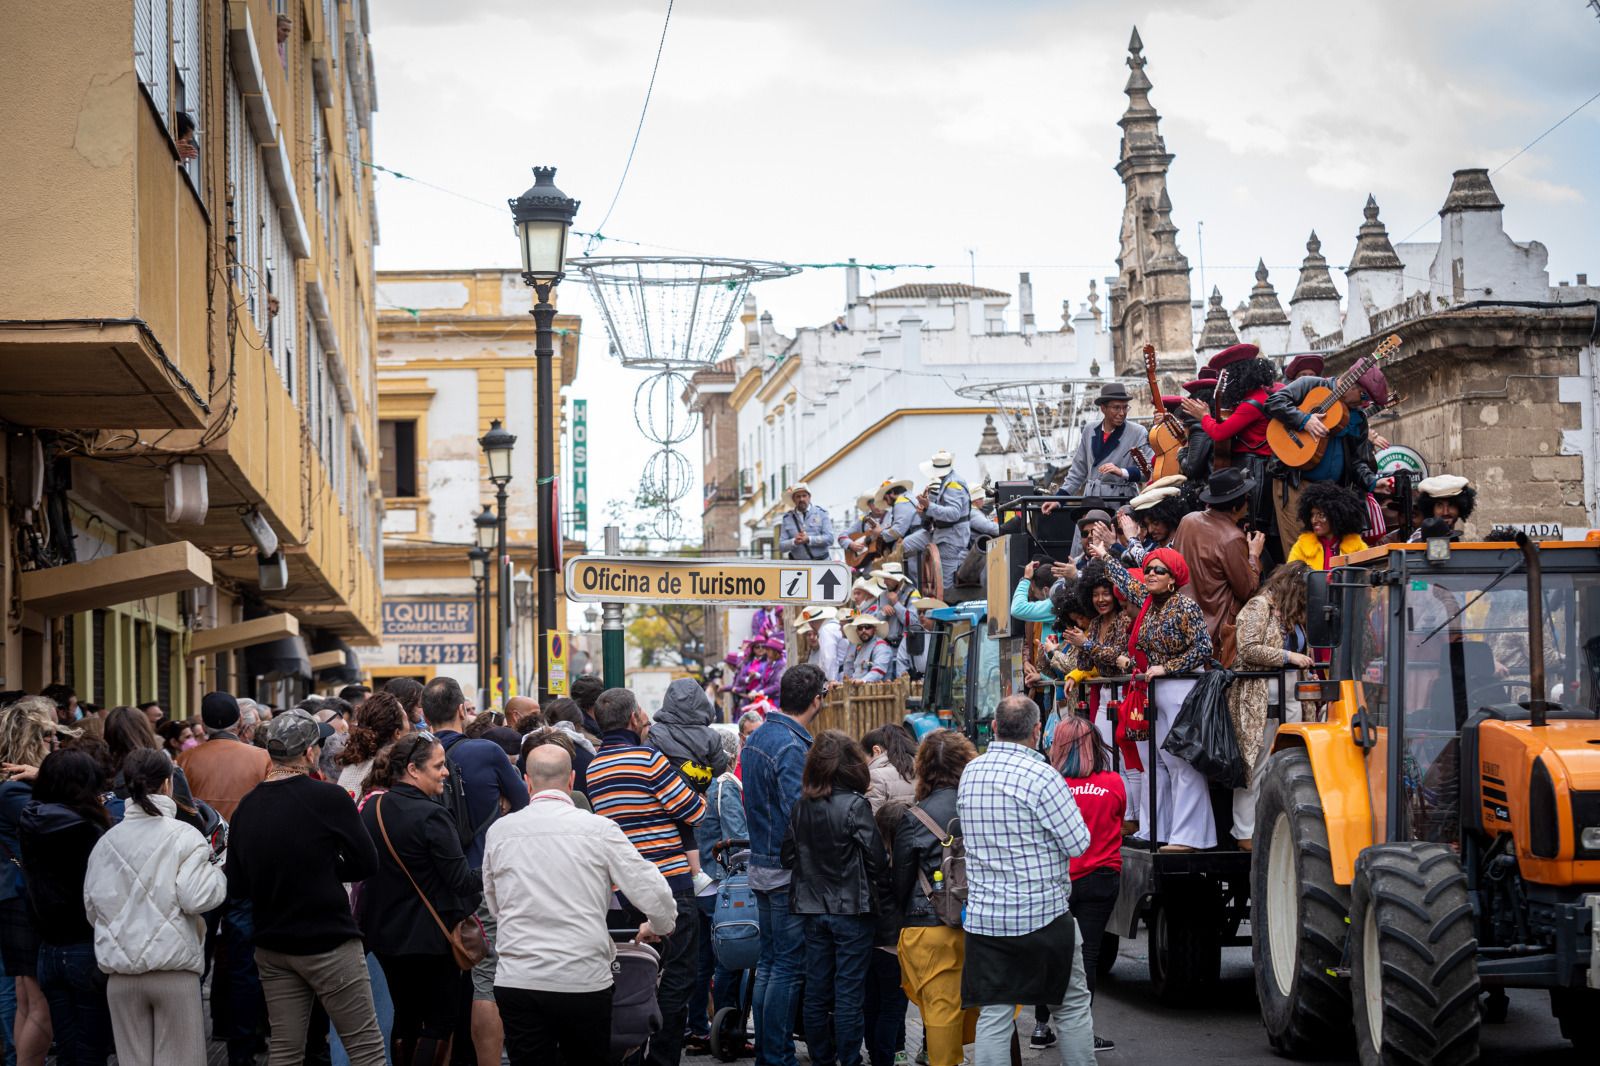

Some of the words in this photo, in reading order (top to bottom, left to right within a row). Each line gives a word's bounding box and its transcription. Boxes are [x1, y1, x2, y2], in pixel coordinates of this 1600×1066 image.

[574, 405, 586, 525] HOSTAL
[583, 566, 650, 593] Oficina
[657, 571, 682, 595] de
[688, 571, 766, 596] Turismo
[383, 603, 470, 623] LQUILER
[387, 622, 467, 633] COMERCIALES
[399, 646, 422, 664] 956
[425, 646, 441, 664] 54
[444, 646, 459, 664] 23
[462, 646, 477, 664] 23
[1069, 783, 1109, 796] onitor
